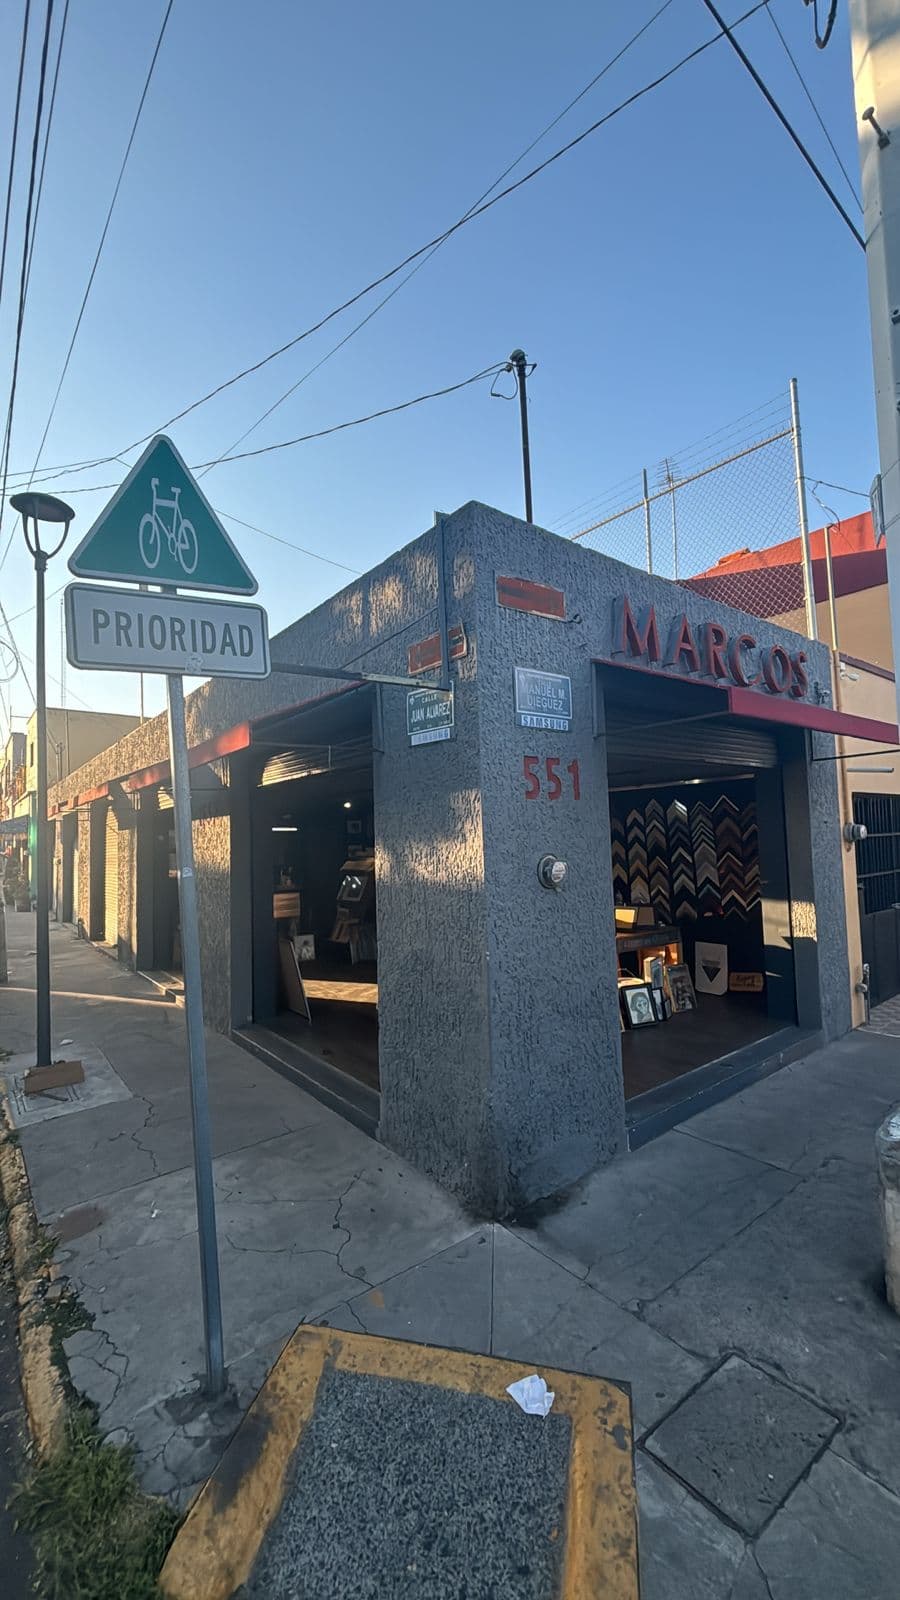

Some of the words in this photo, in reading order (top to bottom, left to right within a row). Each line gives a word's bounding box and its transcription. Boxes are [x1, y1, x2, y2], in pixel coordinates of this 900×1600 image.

[92, 608, 254, 658] PRIORIDAD
[616, 593, 808, 697] MARCOS
[411, 707, 425, 723] JUAN
[527, 694, 563, 711] DIEGUEZ
[523, 715, 567, 730] SAMSUNG
[523, 755, 580, 800] 551
